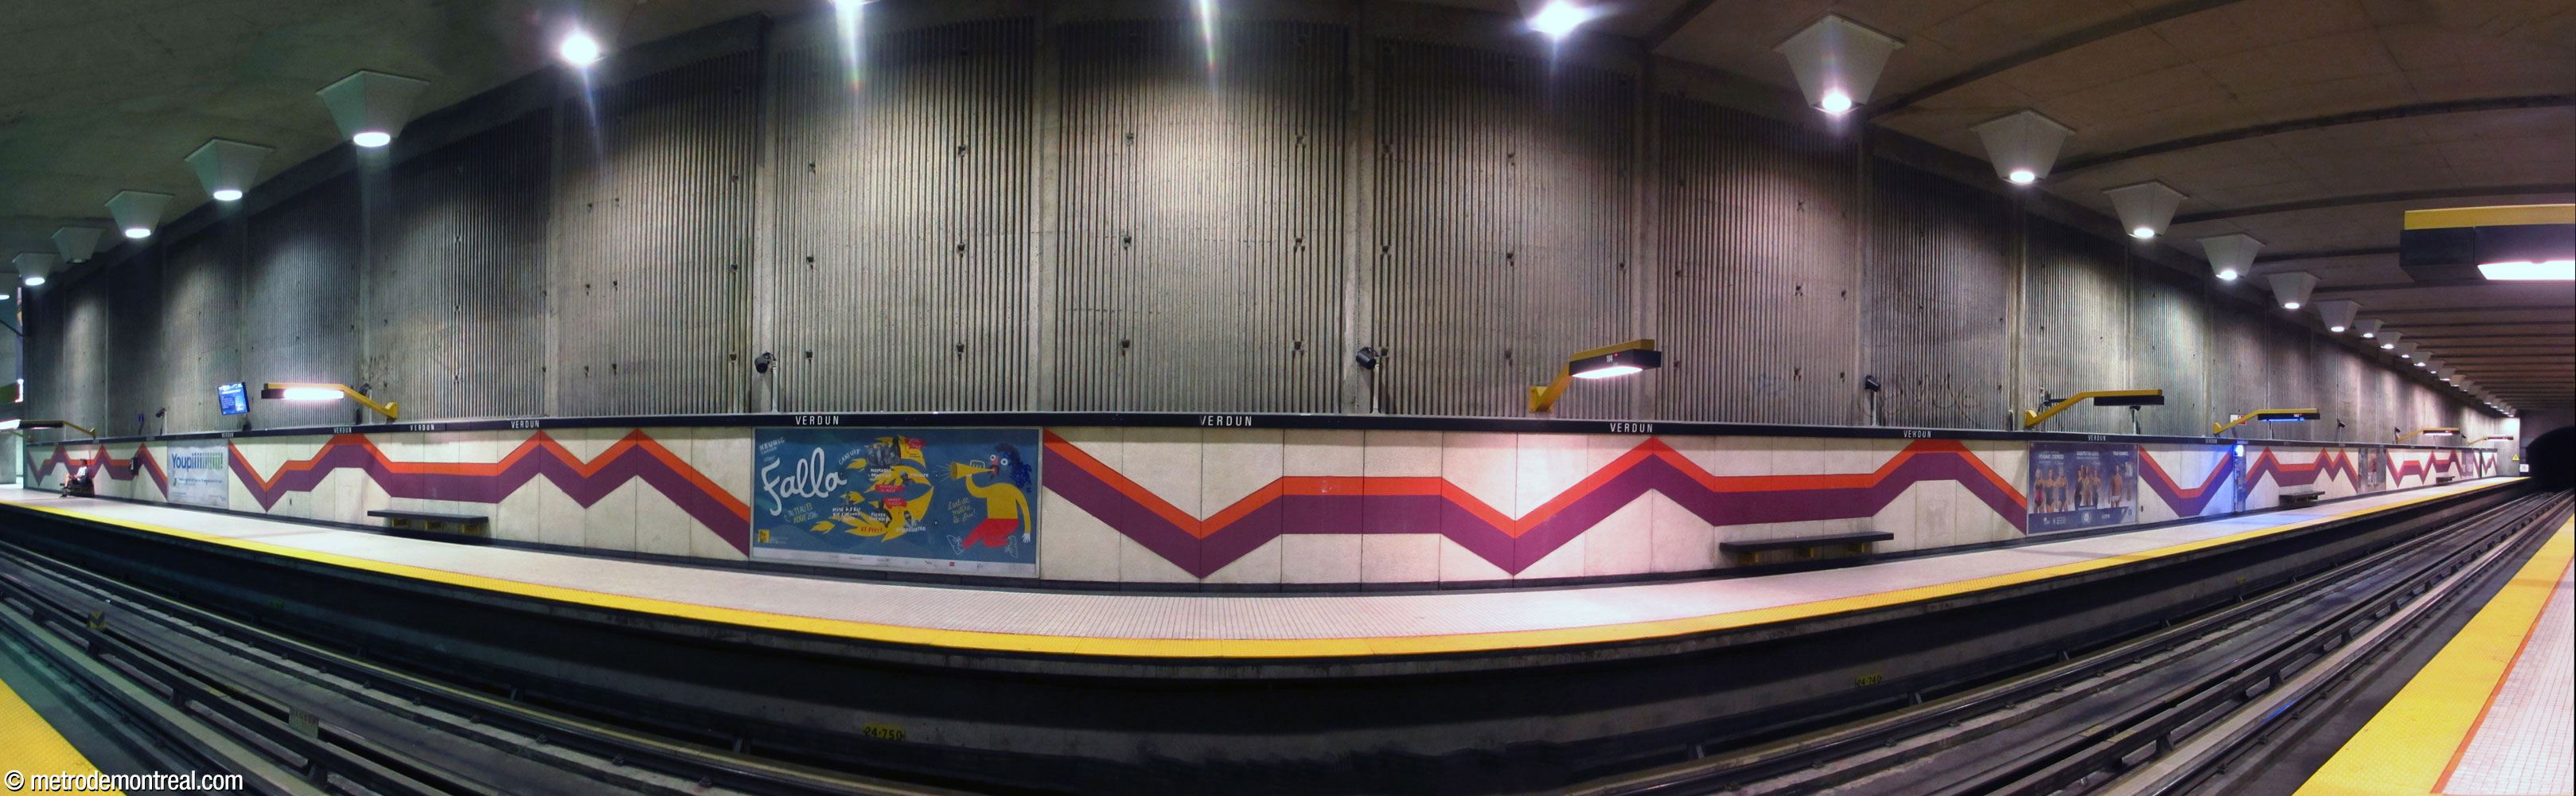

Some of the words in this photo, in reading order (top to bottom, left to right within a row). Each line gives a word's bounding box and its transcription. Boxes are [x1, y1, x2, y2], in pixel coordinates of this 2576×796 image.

[511, 420, 540, 429] VERDUN
[795, 416, 839, 425] VERDUN
[1199, 416, 1252, 426] VERDUN
[1610, 423, 1653, 432] VERDUN
[838, 448, 861, 465] GRATUIT
[761, 447, 848, 517] Falla
